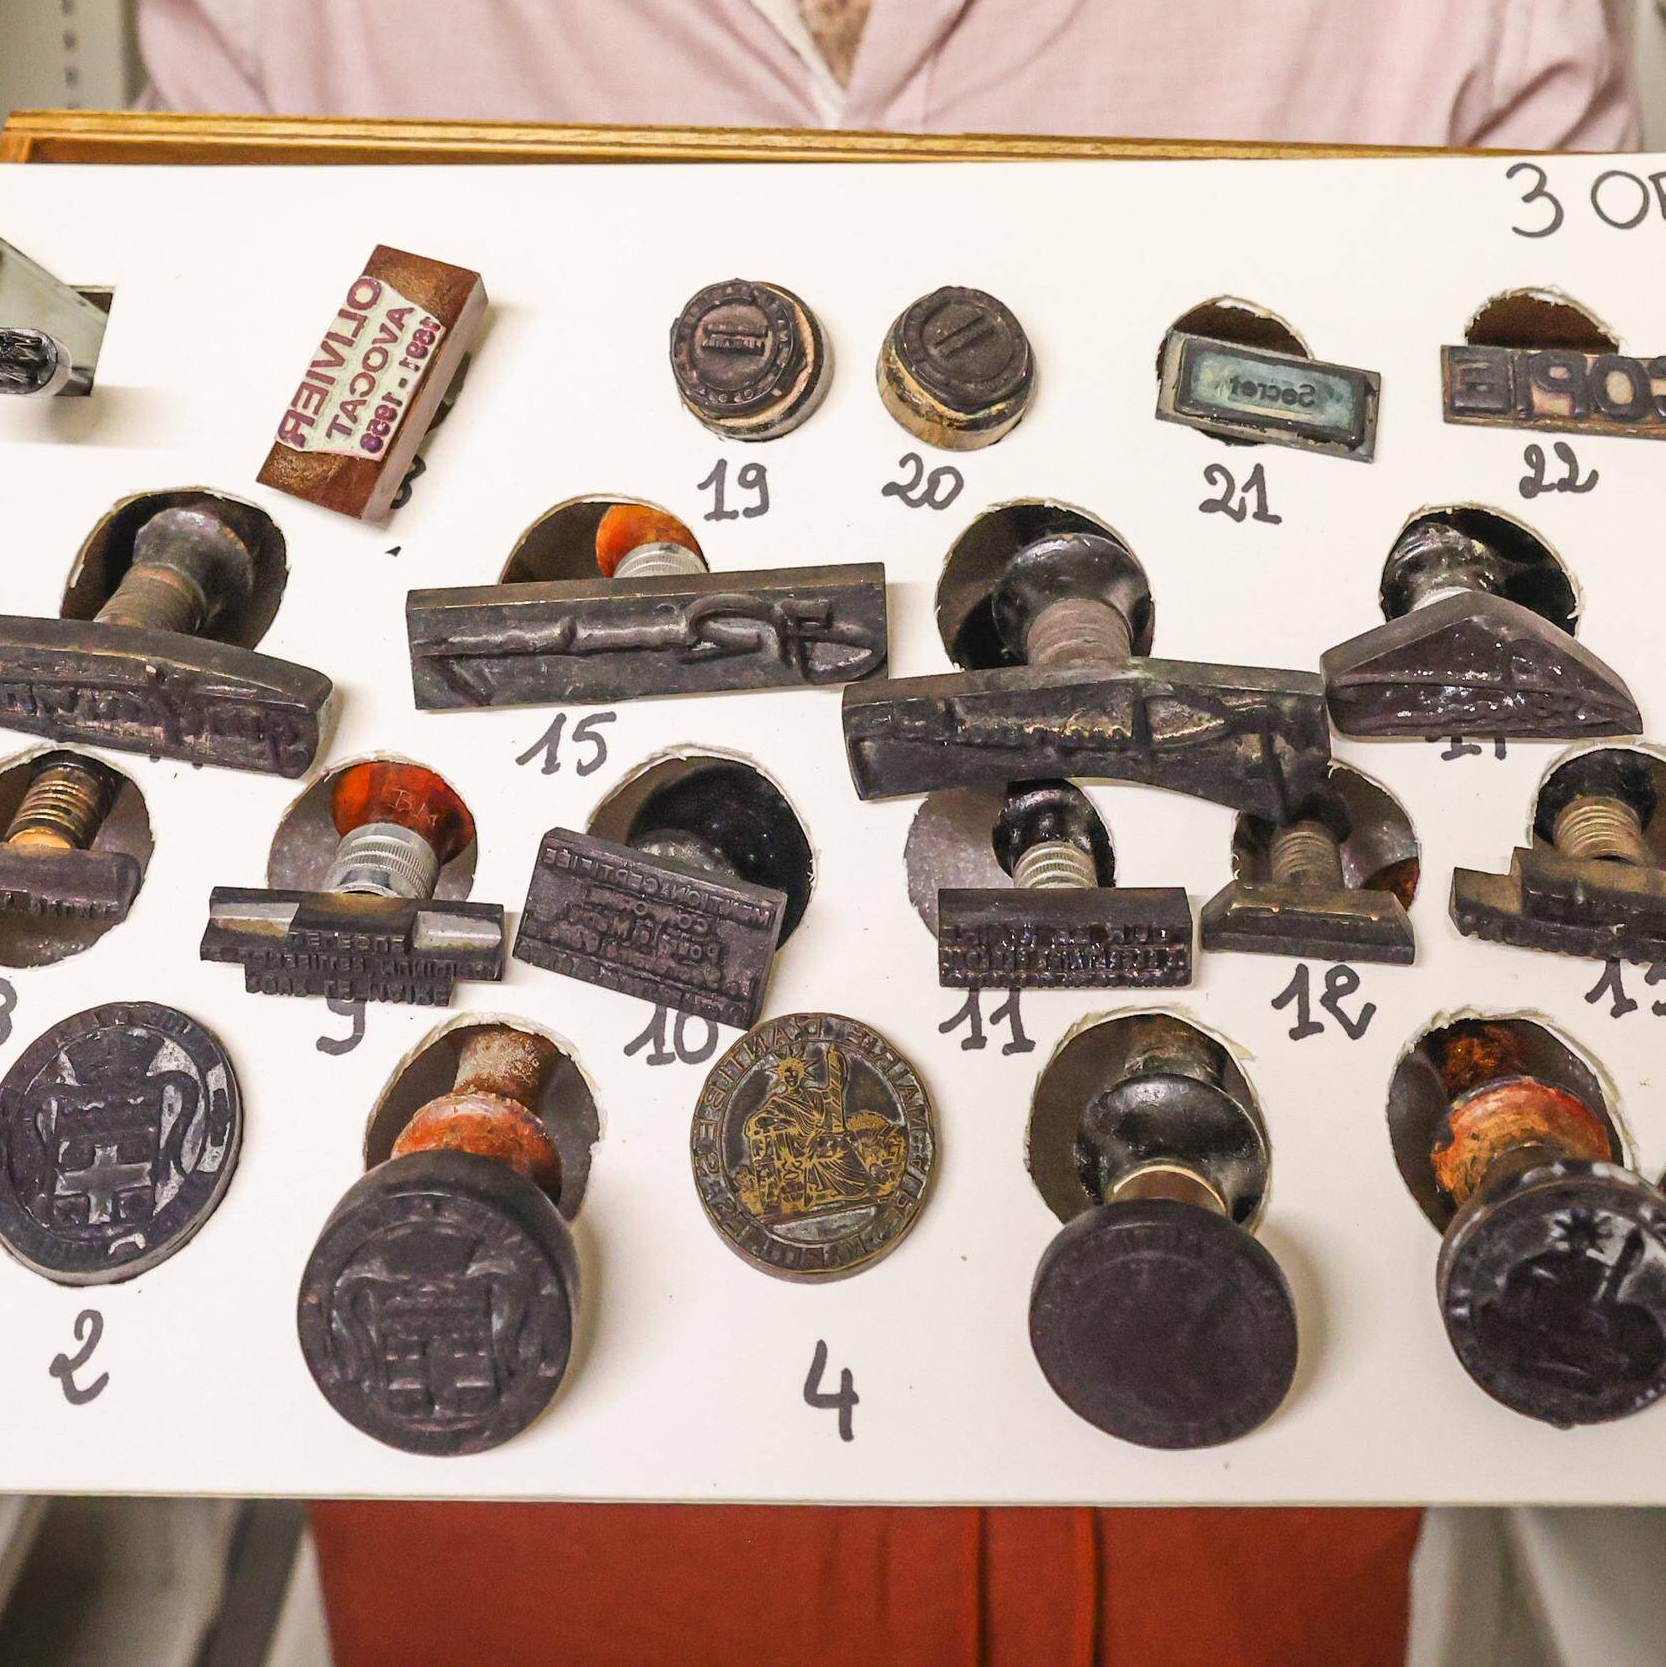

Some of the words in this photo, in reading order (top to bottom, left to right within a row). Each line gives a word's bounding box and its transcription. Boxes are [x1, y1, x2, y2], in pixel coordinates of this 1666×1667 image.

[1505, 162, 1564, 238] 3
[697, 458, 772, 522] 19
[880, 451, 965, 511] 20
[1198, 462, 1282, 527] 21
[1517, 442, 1600, 499] 22
[515, 711, 617, 777] 15
[623, 1003, 720, 1067] 10
[938, 988, 1037, 1056] 11
[1271, 963, 1377, 1041] 12
[49, 1309, 110, 1406] 2
[803, 1339, 860, 1442] 4
